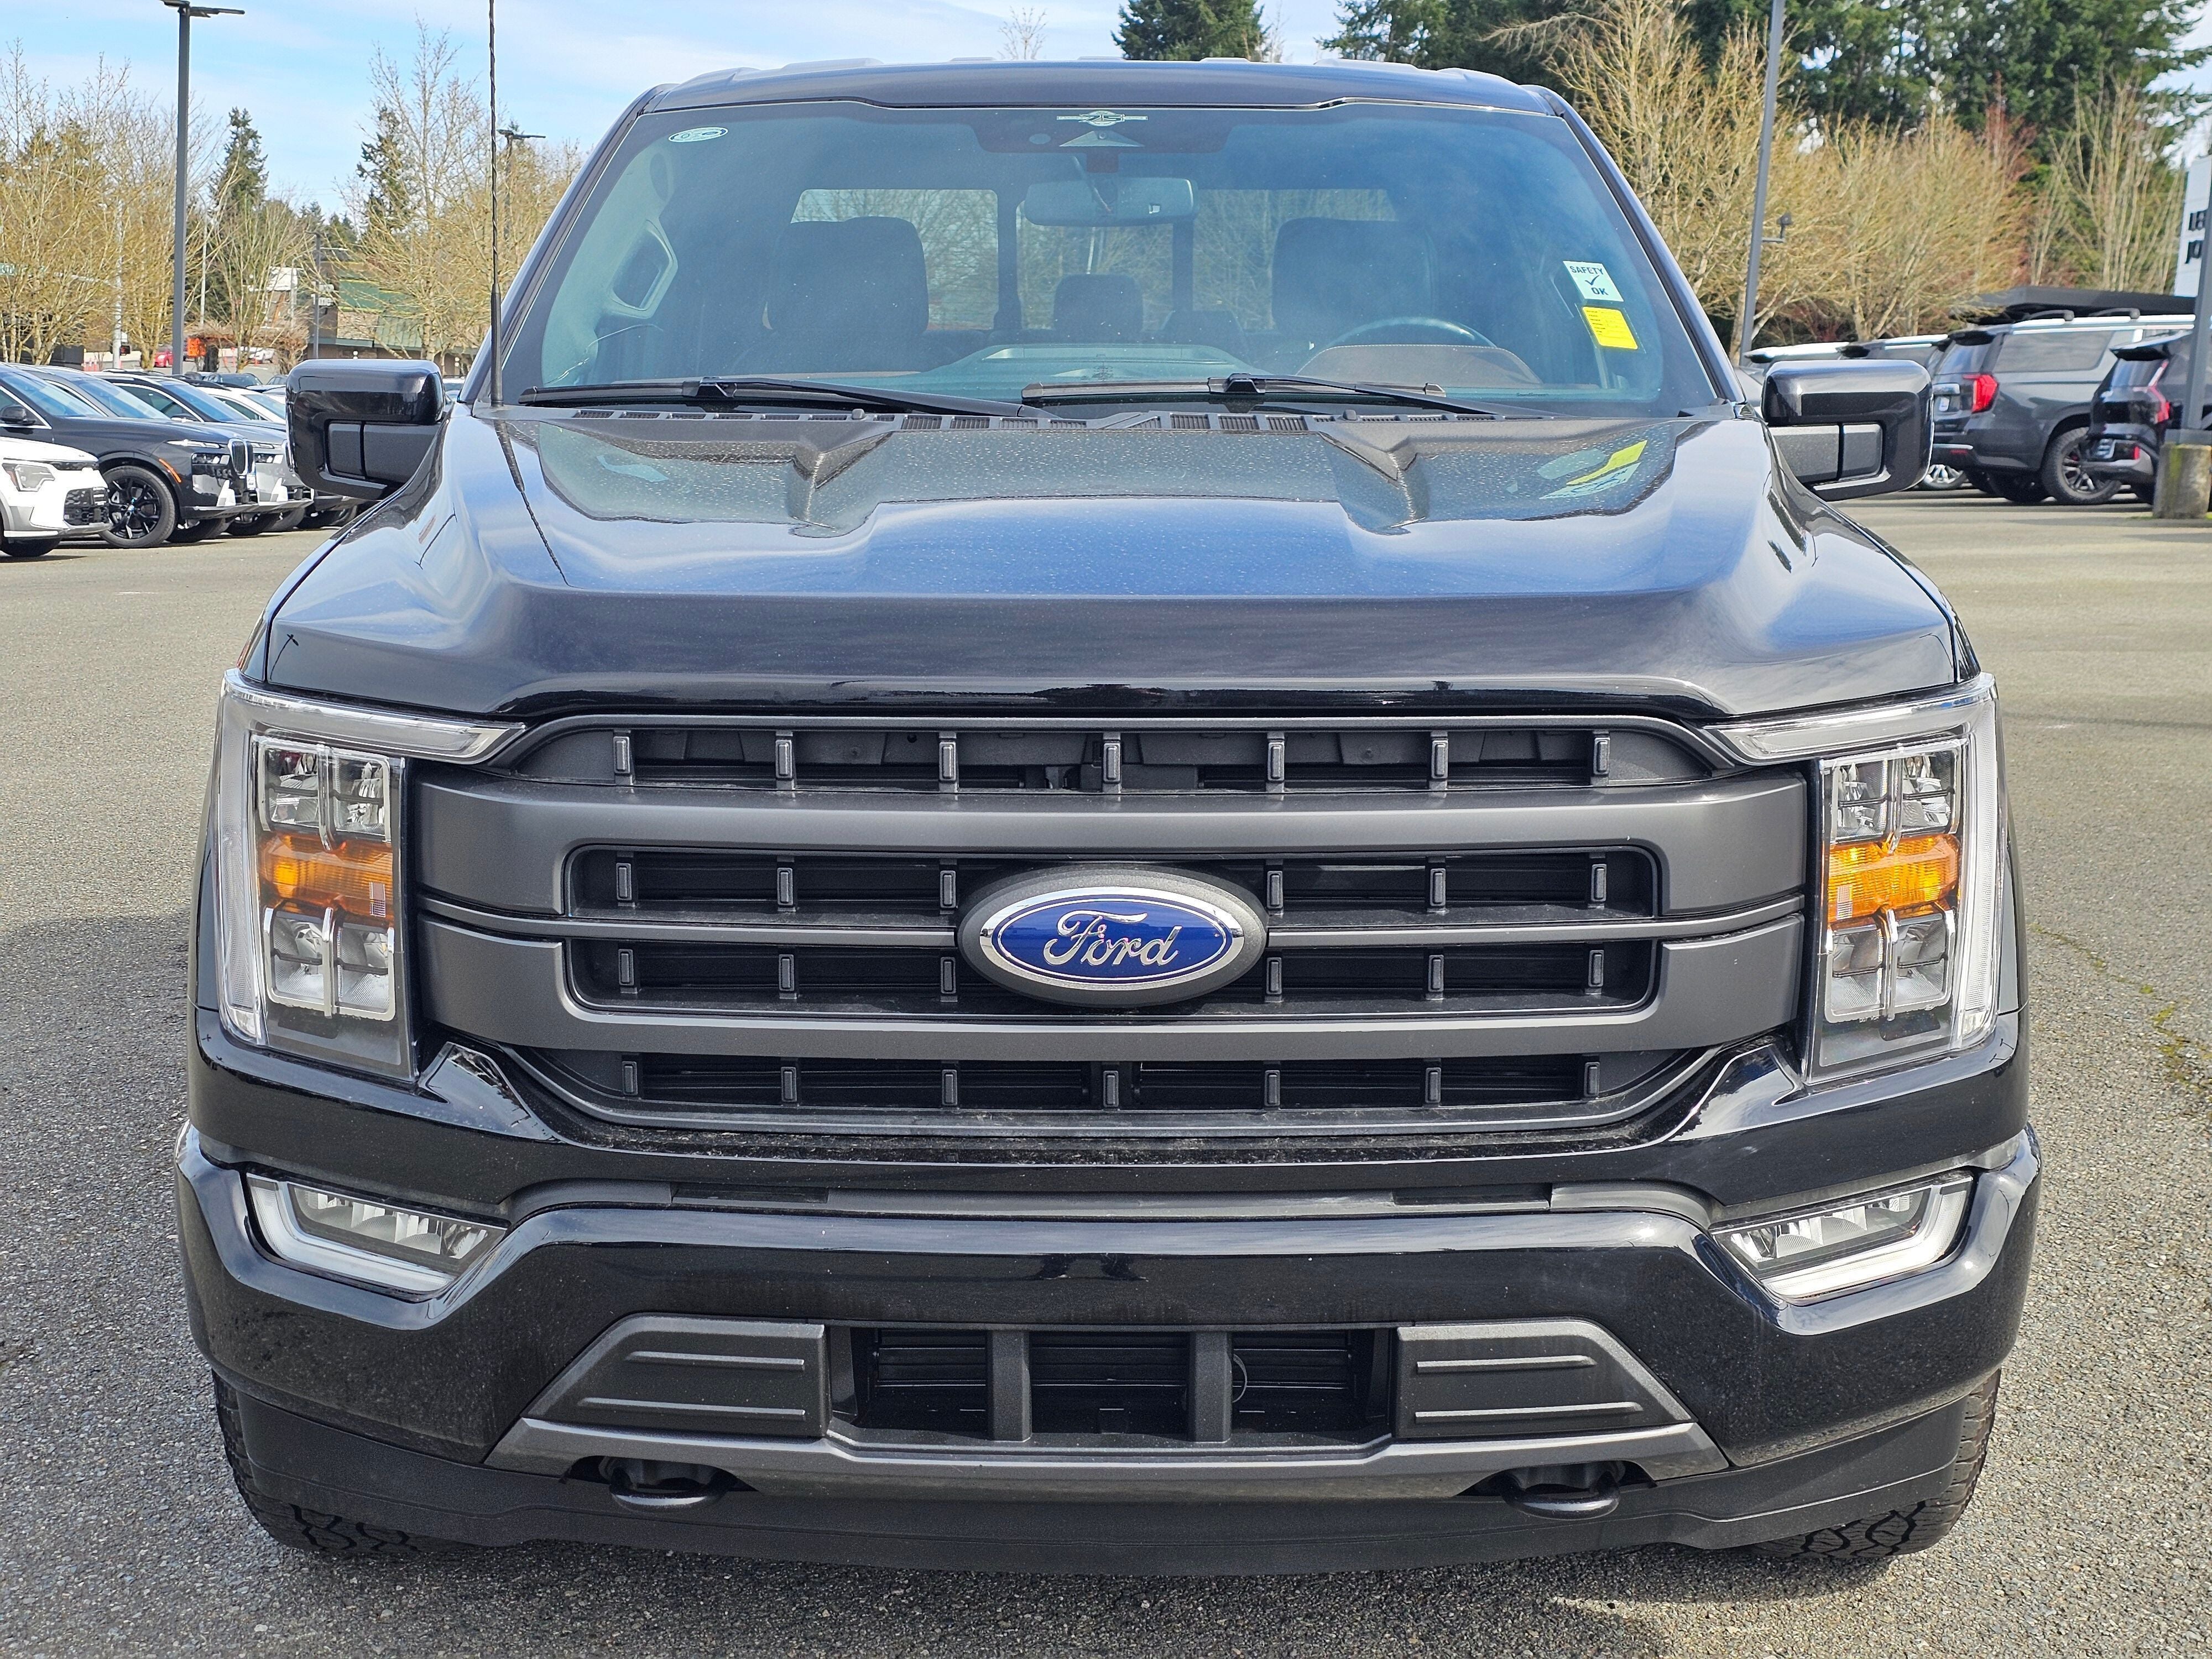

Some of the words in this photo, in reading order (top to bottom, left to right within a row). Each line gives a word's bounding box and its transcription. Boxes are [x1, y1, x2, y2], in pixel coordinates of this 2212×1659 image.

[1569, 265, 1604, 275] SAFETY
[1591, 287, 1609, 296] OK
[1043, 909, 1183, 966] Ford
